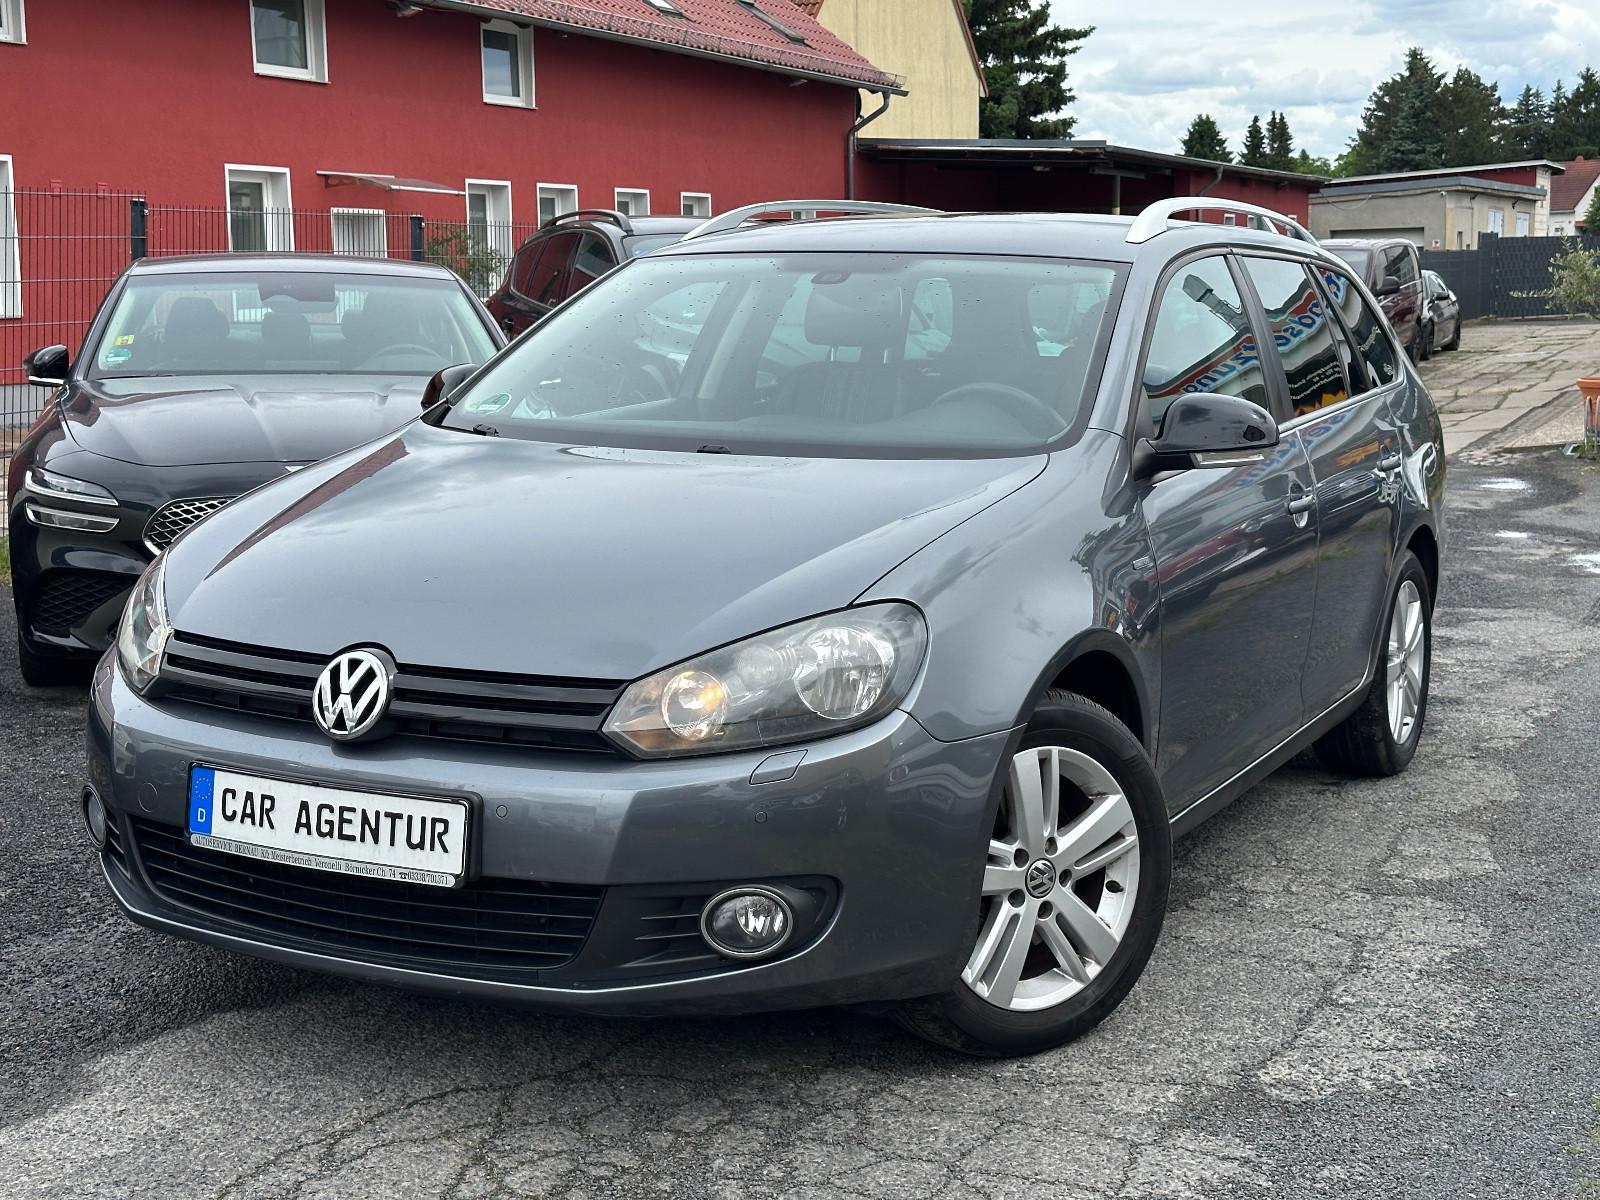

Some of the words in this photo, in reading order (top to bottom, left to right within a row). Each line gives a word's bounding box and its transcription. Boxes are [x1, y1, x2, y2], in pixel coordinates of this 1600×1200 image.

[197, 807, 206, 822] D
[221, 787, 276, 830] CAR
[294, 800, 450, 853] AGENTUR
[194, 836, 233, 851] AUTOSERVICE
[234, 843, 259, 857] BERNAU
[389, 868, 396, 878] 74
